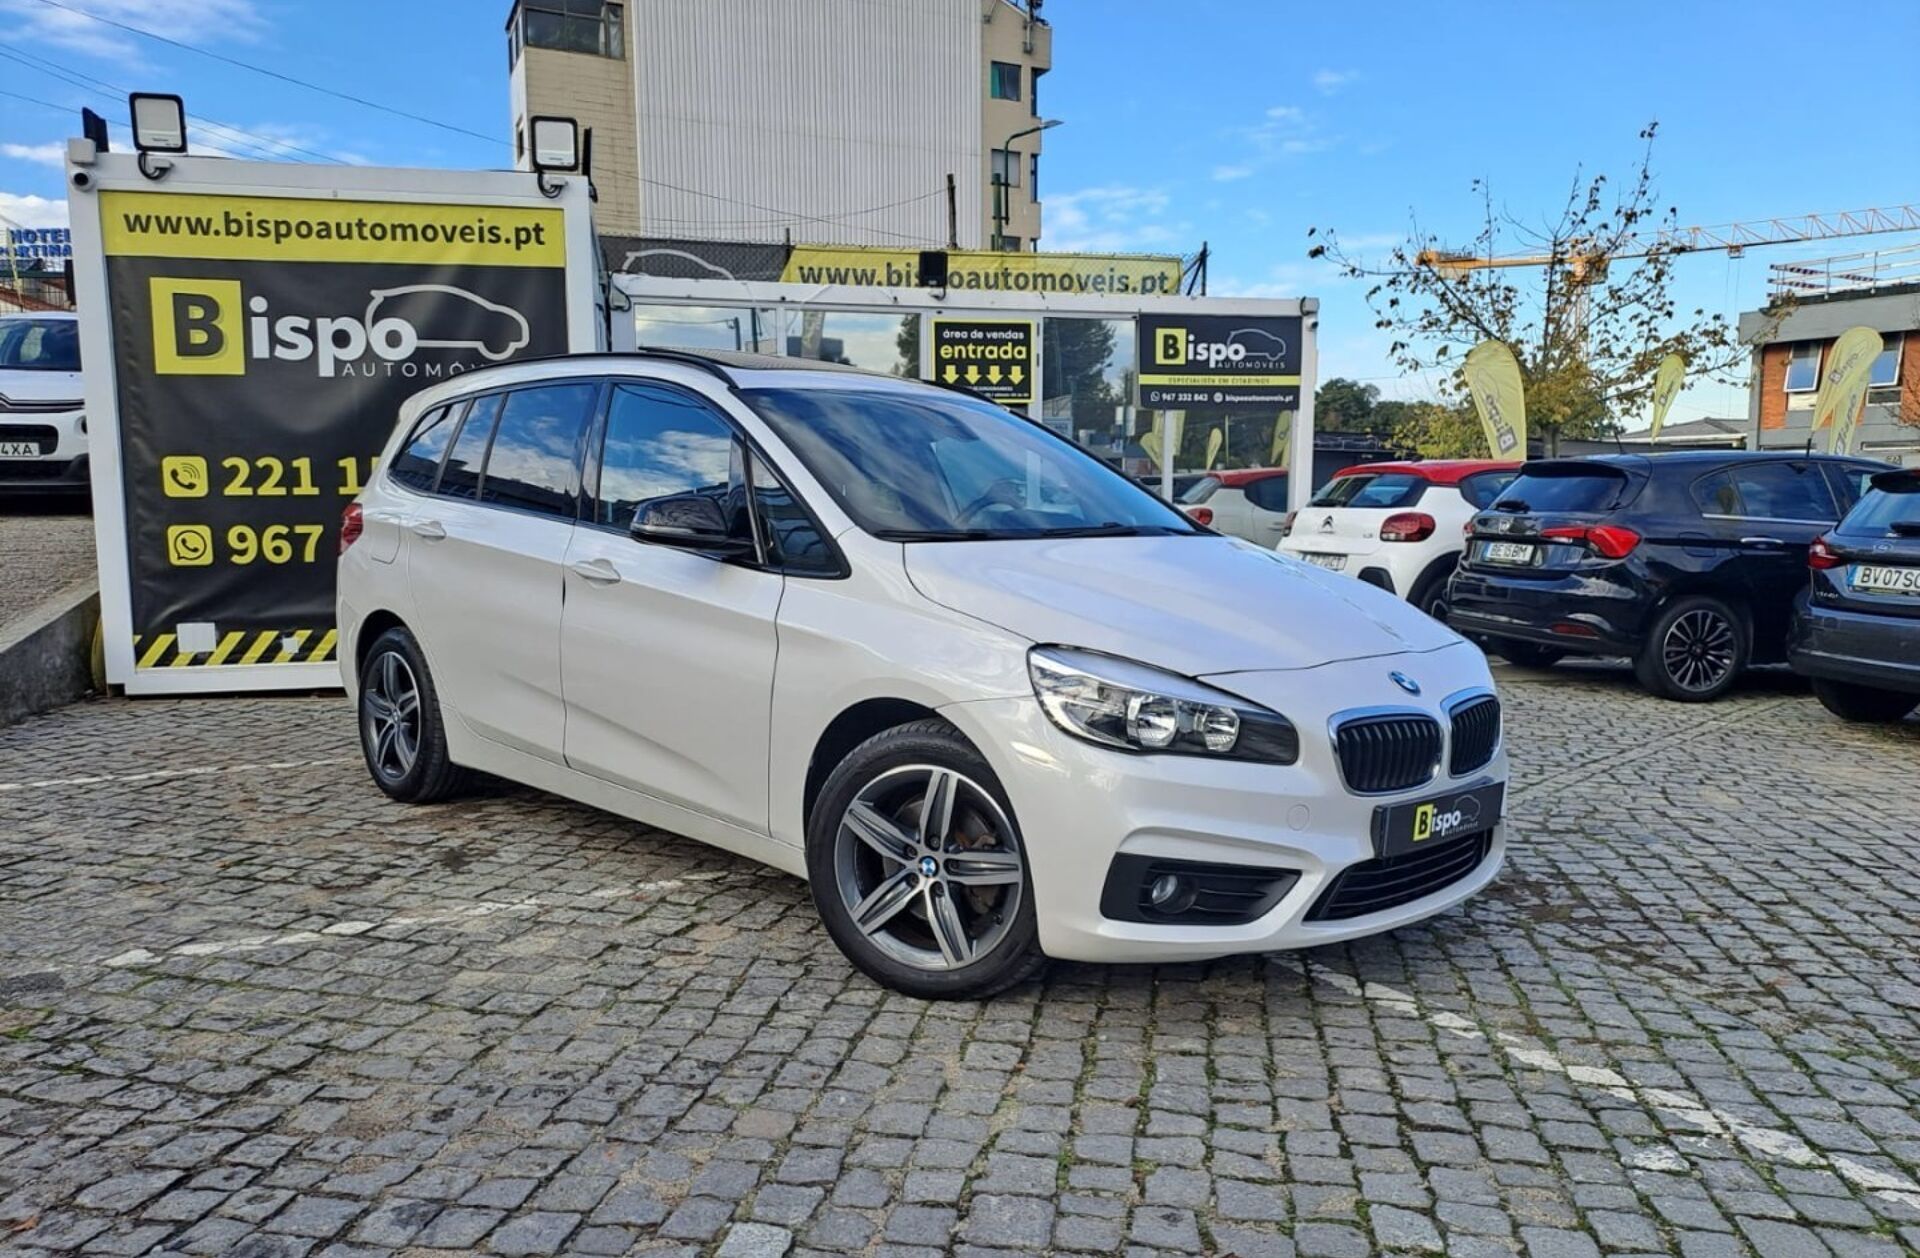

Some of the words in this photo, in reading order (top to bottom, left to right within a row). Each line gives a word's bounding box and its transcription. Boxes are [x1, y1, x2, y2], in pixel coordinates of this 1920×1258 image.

[123, 211, 545, 250] www.bispoautomoveis.pt
[798, 262, 1168, 294] www.bioautomoveis.pt
[171, 291, 418, 378] Bispo
[940, 341, 1027, 359] entrada
[970, 329, 984, 339] de
[986, 330, 1024, 340] vendas
[1163, 333, 1246, 368] Bispo
[221, 456, 320, 496] 221
[337, 457, 382, 495] 1
[227, 524, 324, 565] 967
[1417, 807, 1462, 837] Bispo
